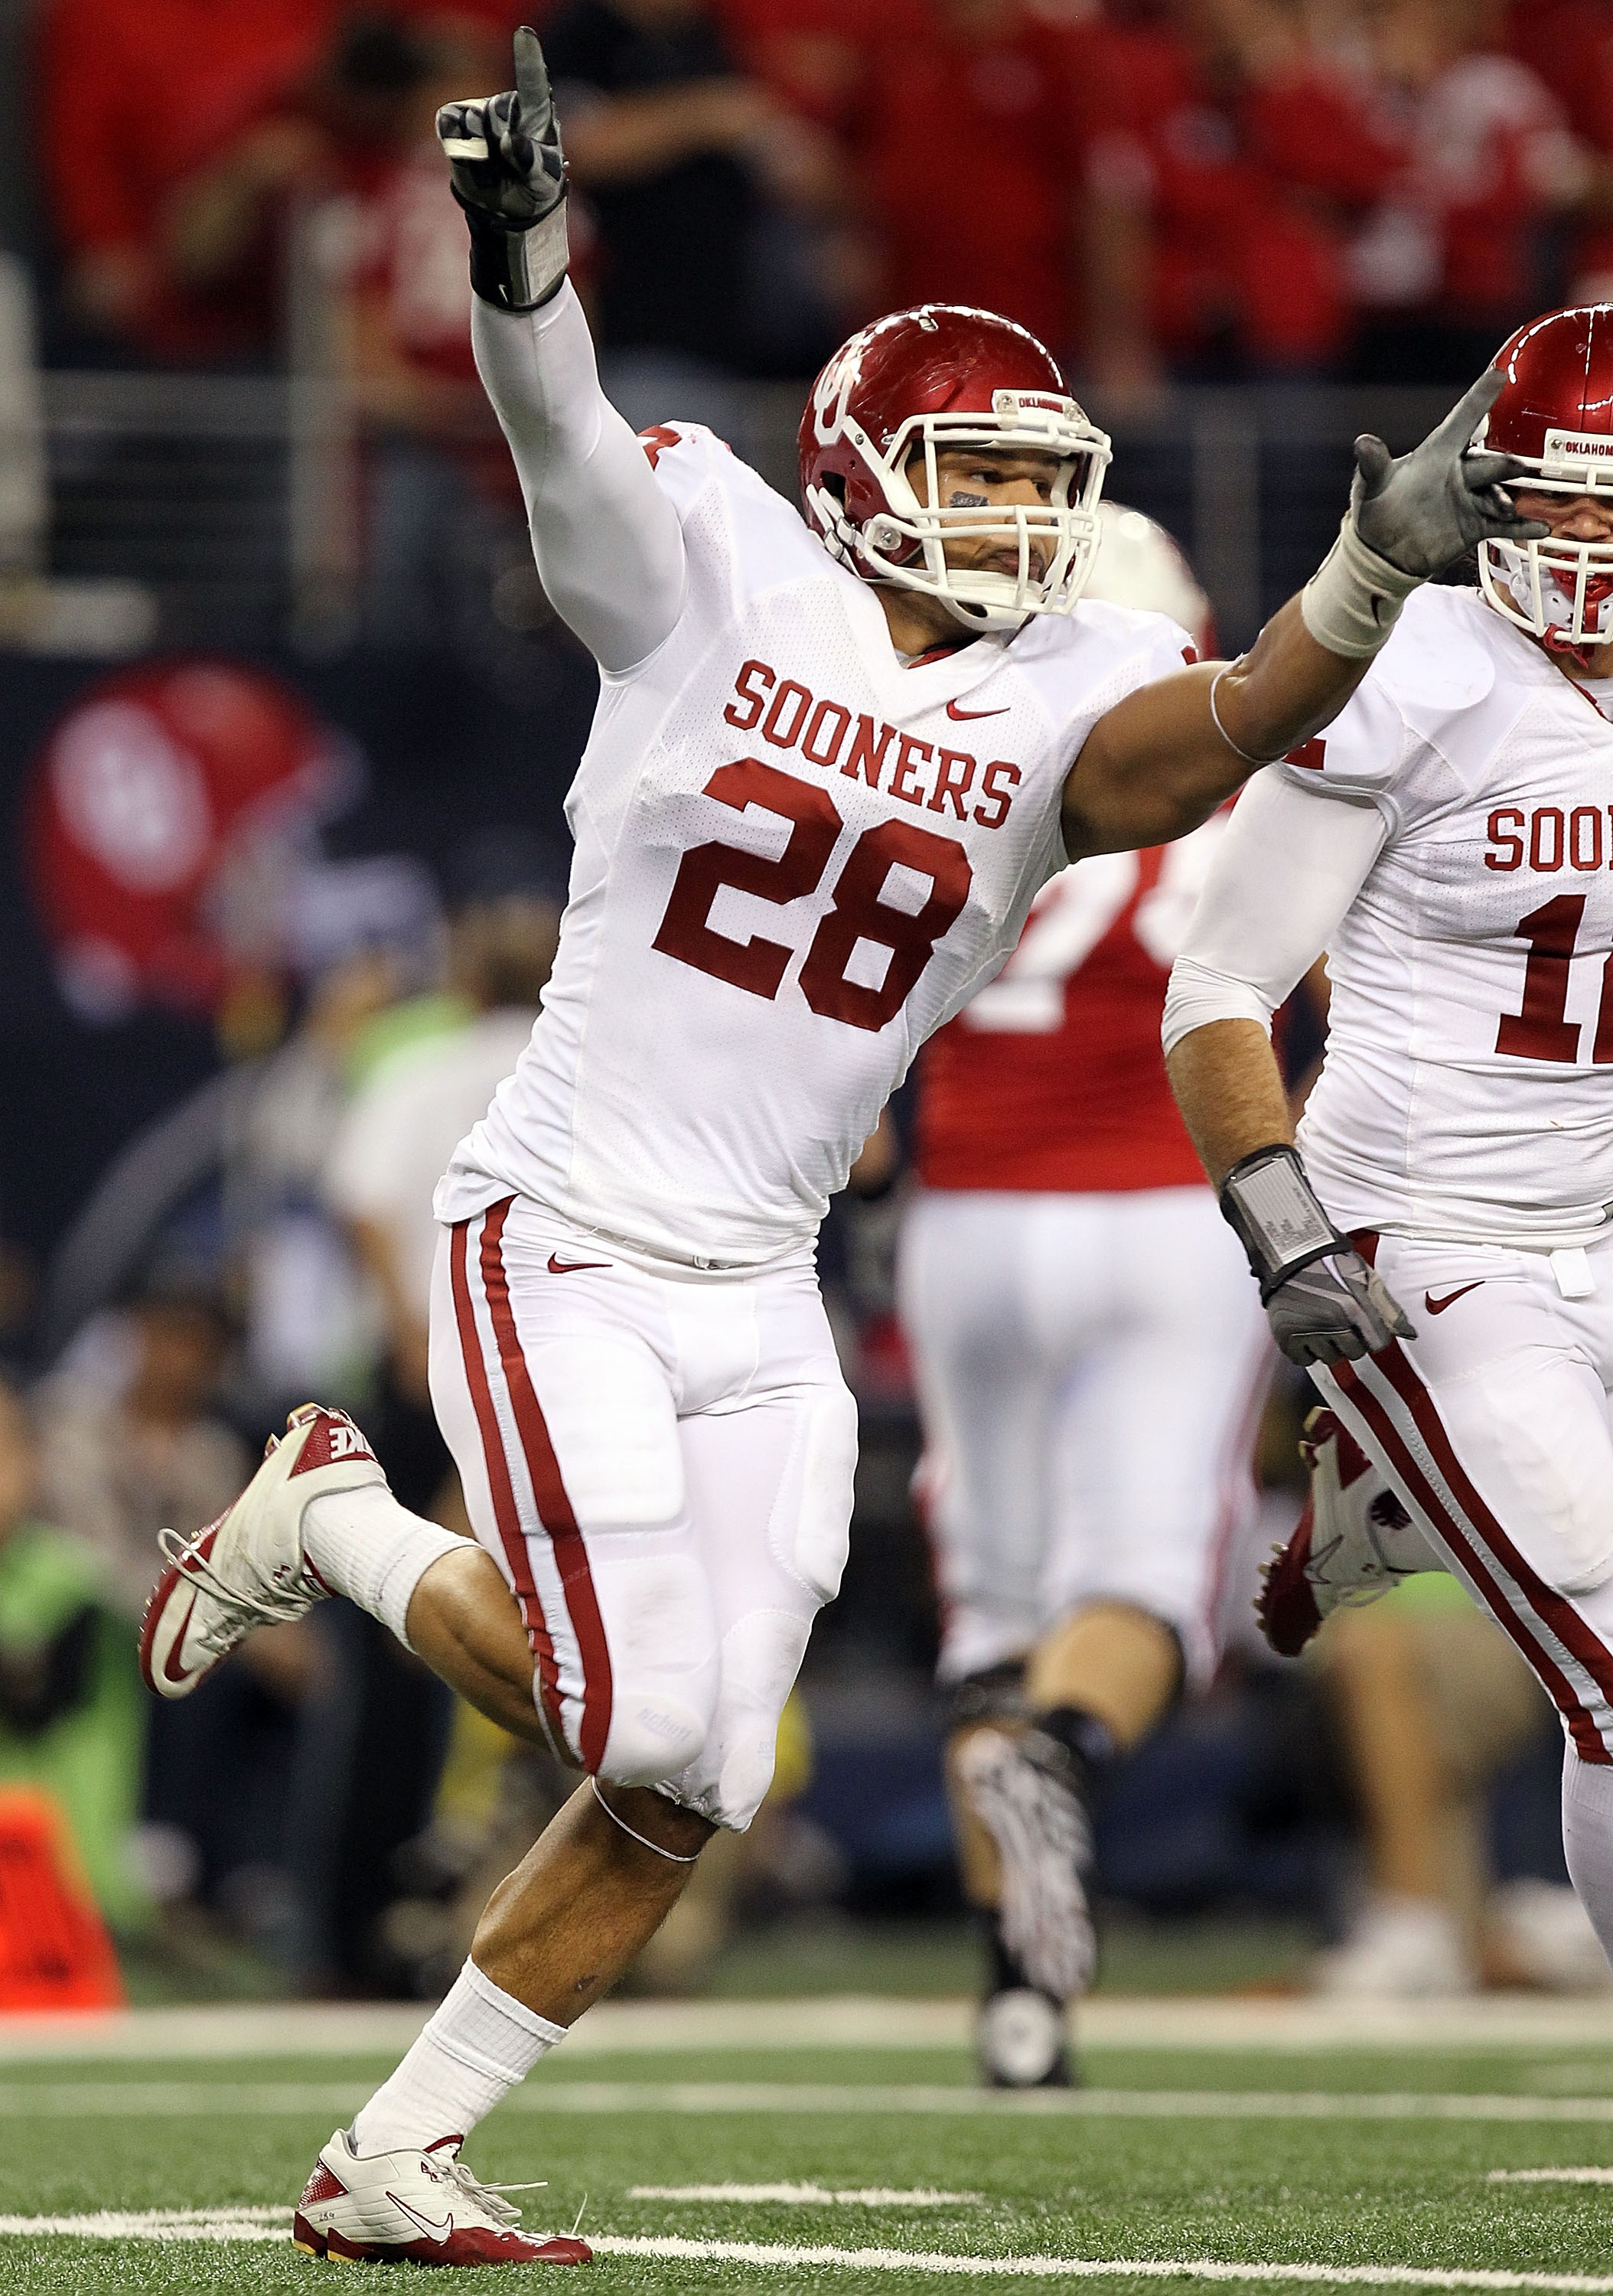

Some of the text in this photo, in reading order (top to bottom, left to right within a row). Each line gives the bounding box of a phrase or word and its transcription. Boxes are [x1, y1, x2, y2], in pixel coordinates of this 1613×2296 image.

[723, 659, 1022, 830] SOONERS
[651, 757, 973, 1032] 28
[1484, 806, 1613, 872] SOO
[1494, 894, 1613, 1065] 1
